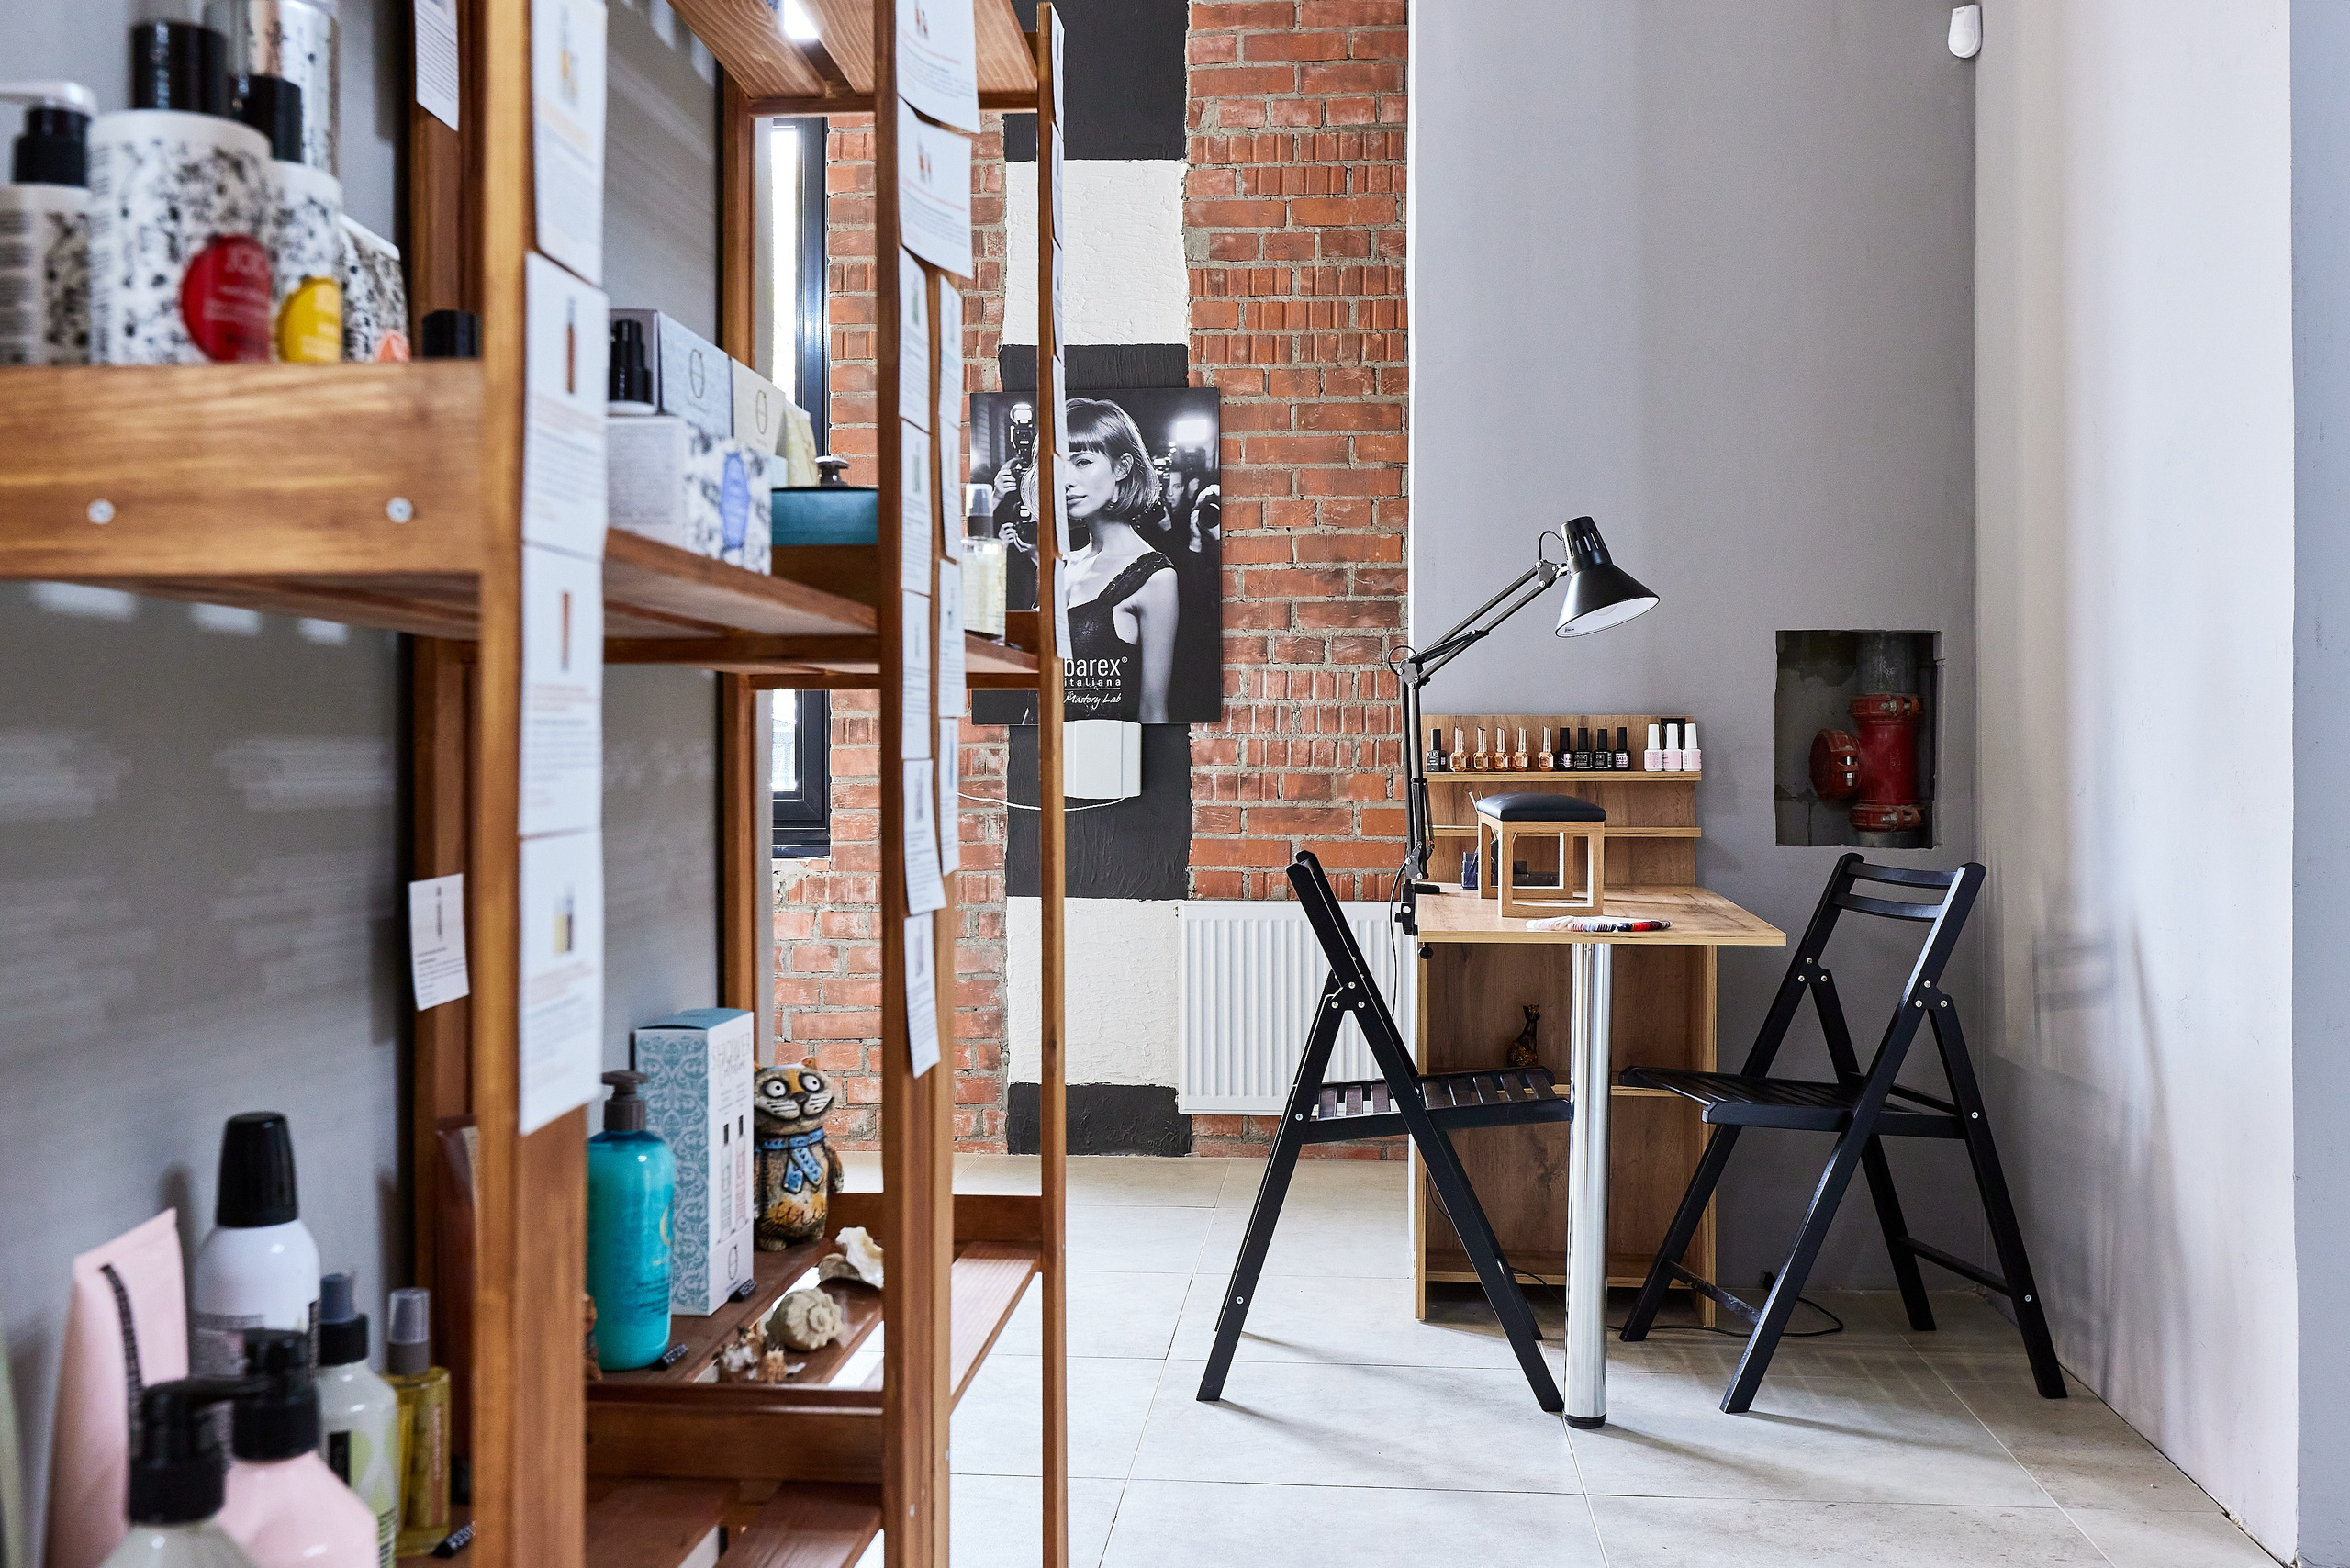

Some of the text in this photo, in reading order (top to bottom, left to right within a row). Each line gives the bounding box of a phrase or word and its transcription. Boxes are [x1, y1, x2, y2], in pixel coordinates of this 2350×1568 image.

[1064, 678, 1121, 687] italiana
[1064, 691, 1122, 710] Mastery Lab
